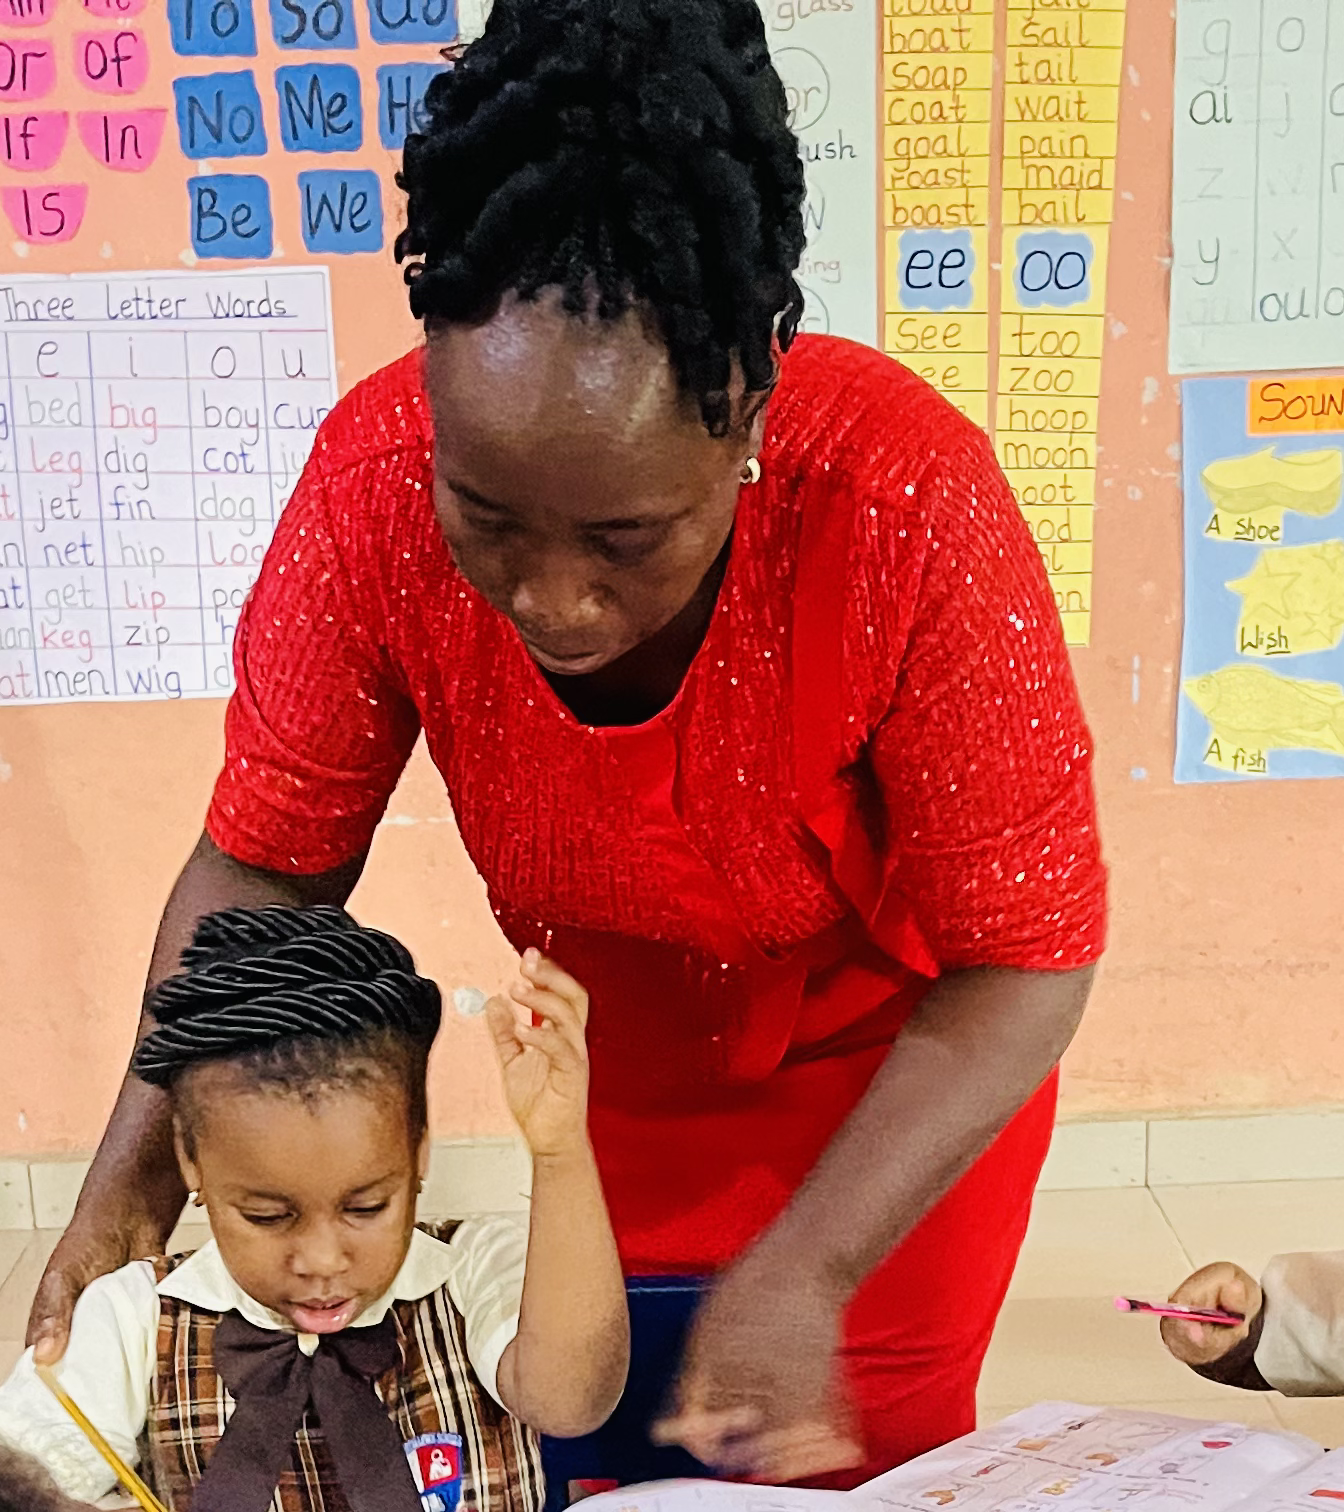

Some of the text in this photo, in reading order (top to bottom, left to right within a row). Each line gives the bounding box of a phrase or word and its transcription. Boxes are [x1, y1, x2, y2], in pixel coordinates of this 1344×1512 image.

[890, 16, 971, 52] boat
[84, 31, 138, 88] Of
[1015, 47, 1078, 84] tail
[188, 90, 255, 149] No
[284, 74, 353, 141] Me
[888, 91, 966, 122] coat
[1015, 92, 1088, 121] wait
[1189, 86, 1232, 125] ai
[3, 115, 37, 160] If
[102, 115, 139, 164] In
[893, 127, 970, 172] goal
[1020, 131, 1089, 169] pain
[891, 160, 970, 190] roast
[1025, 159, 1103, 188] maid
[196, 188, 261, 244] Be
[306, 185, 372, 239] We
[892, 193, 975, 226] boast
[1019, 190, 1086, 224] bail
[905, 249, 965, 288] ee
[1021, 250, 1086, 291] oo
[1193, 237, 1220, 286] y
[207, 280, 286, 317] Words
[1259, 286, 1309, 322] ou
[1012, 314, 1080, 357] too
[37, 341, 59, 378] e
[128, 337, 137, 378] i
[211, 346, 236, 378] o
[282, 348, 305, 378] u
[1010, 366, 1074, 392] zoo
[26, 382, 81, 427] bed
[109, 385, 156, 444] big
[202, 389, 260, 445] boy
[1009, 399, 1089, 446] hoop
[31, 434, 82, 487] leg
[104, 439, 148, 489] dig
[202, 441, 254, 474] cot
[1004, 441, 1088, 468] moon
[36, 491, 81, 531] jet
[111, 486, 156, 520] fin
[200, 483, 255, 536] dog
[1205, 515, 1220, 534] A
[44, 541, 94, 566] net
[119, 537, 164, 577] hip
[46, 584, 94, 624] get
[124, 582, 165, 622] lip
[41, 623, 92, 661] keg
[125, 627, 170, 659] zip
[44, 670, 109, 695] men
[127, 669, 182, 698] wig
[1203, 738, 1266, 772] A fish
